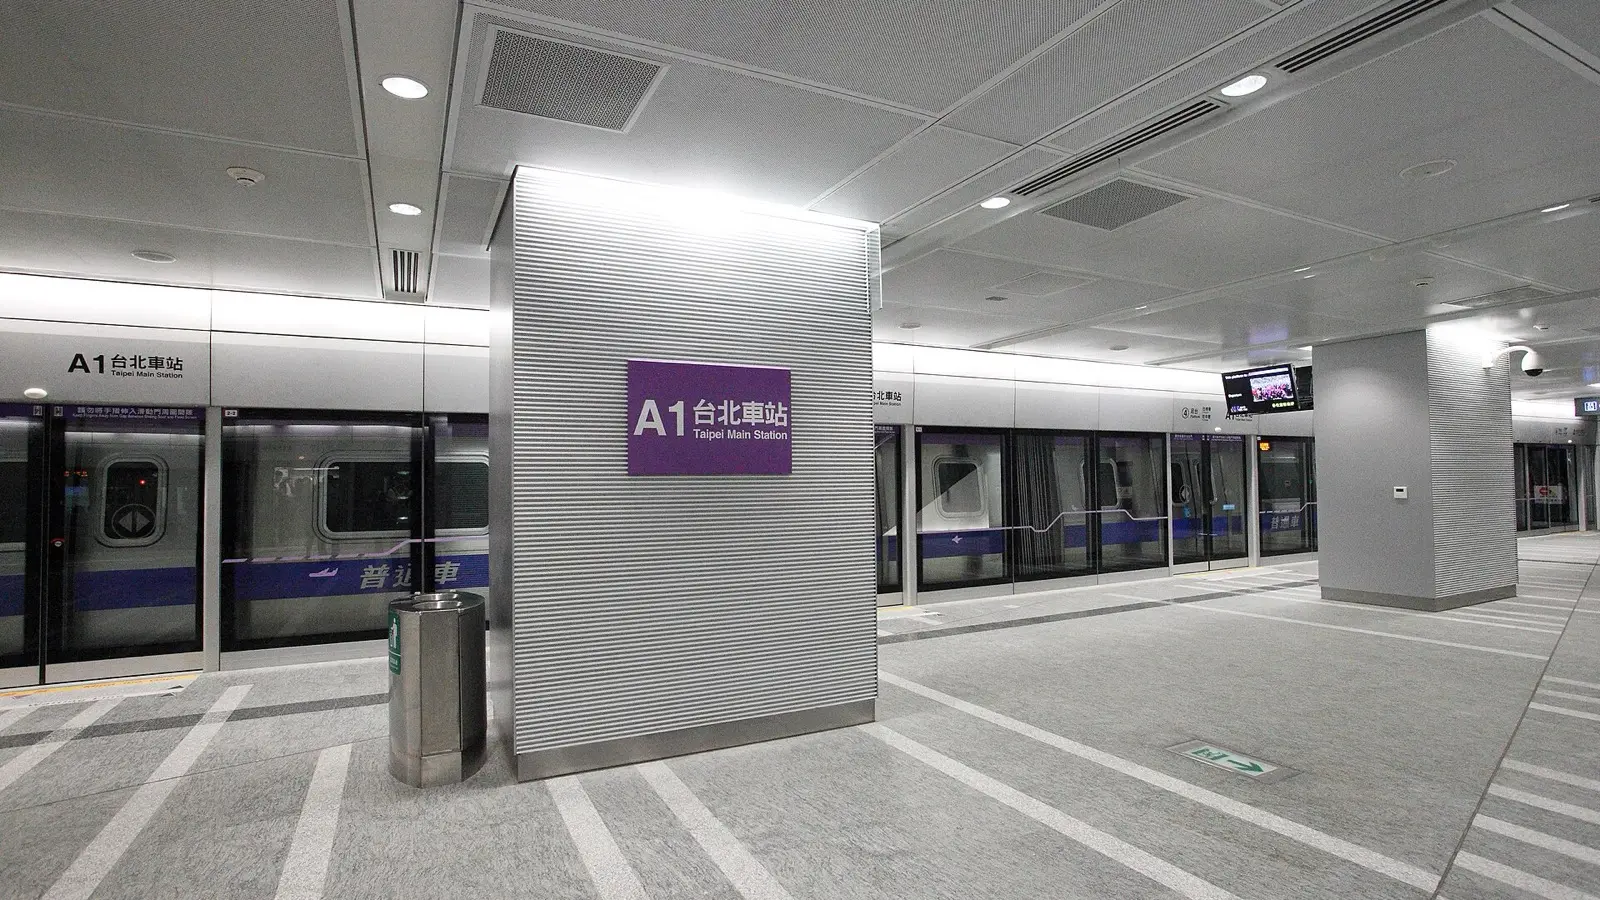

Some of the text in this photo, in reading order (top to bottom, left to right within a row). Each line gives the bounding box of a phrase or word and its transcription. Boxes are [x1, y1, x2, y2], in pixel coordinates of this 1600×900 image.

[67, 353, 105, 374] A1
[110, 354, 183, 371] 台北車站
[111, 370, 135, 378] Taipei
[156, 371, 183, 379] Station
[633, 399, 685, 437] A1
[692, 398, 788, 427] 台北車站
[693, 428, 788, 443] Taipei Main Station
